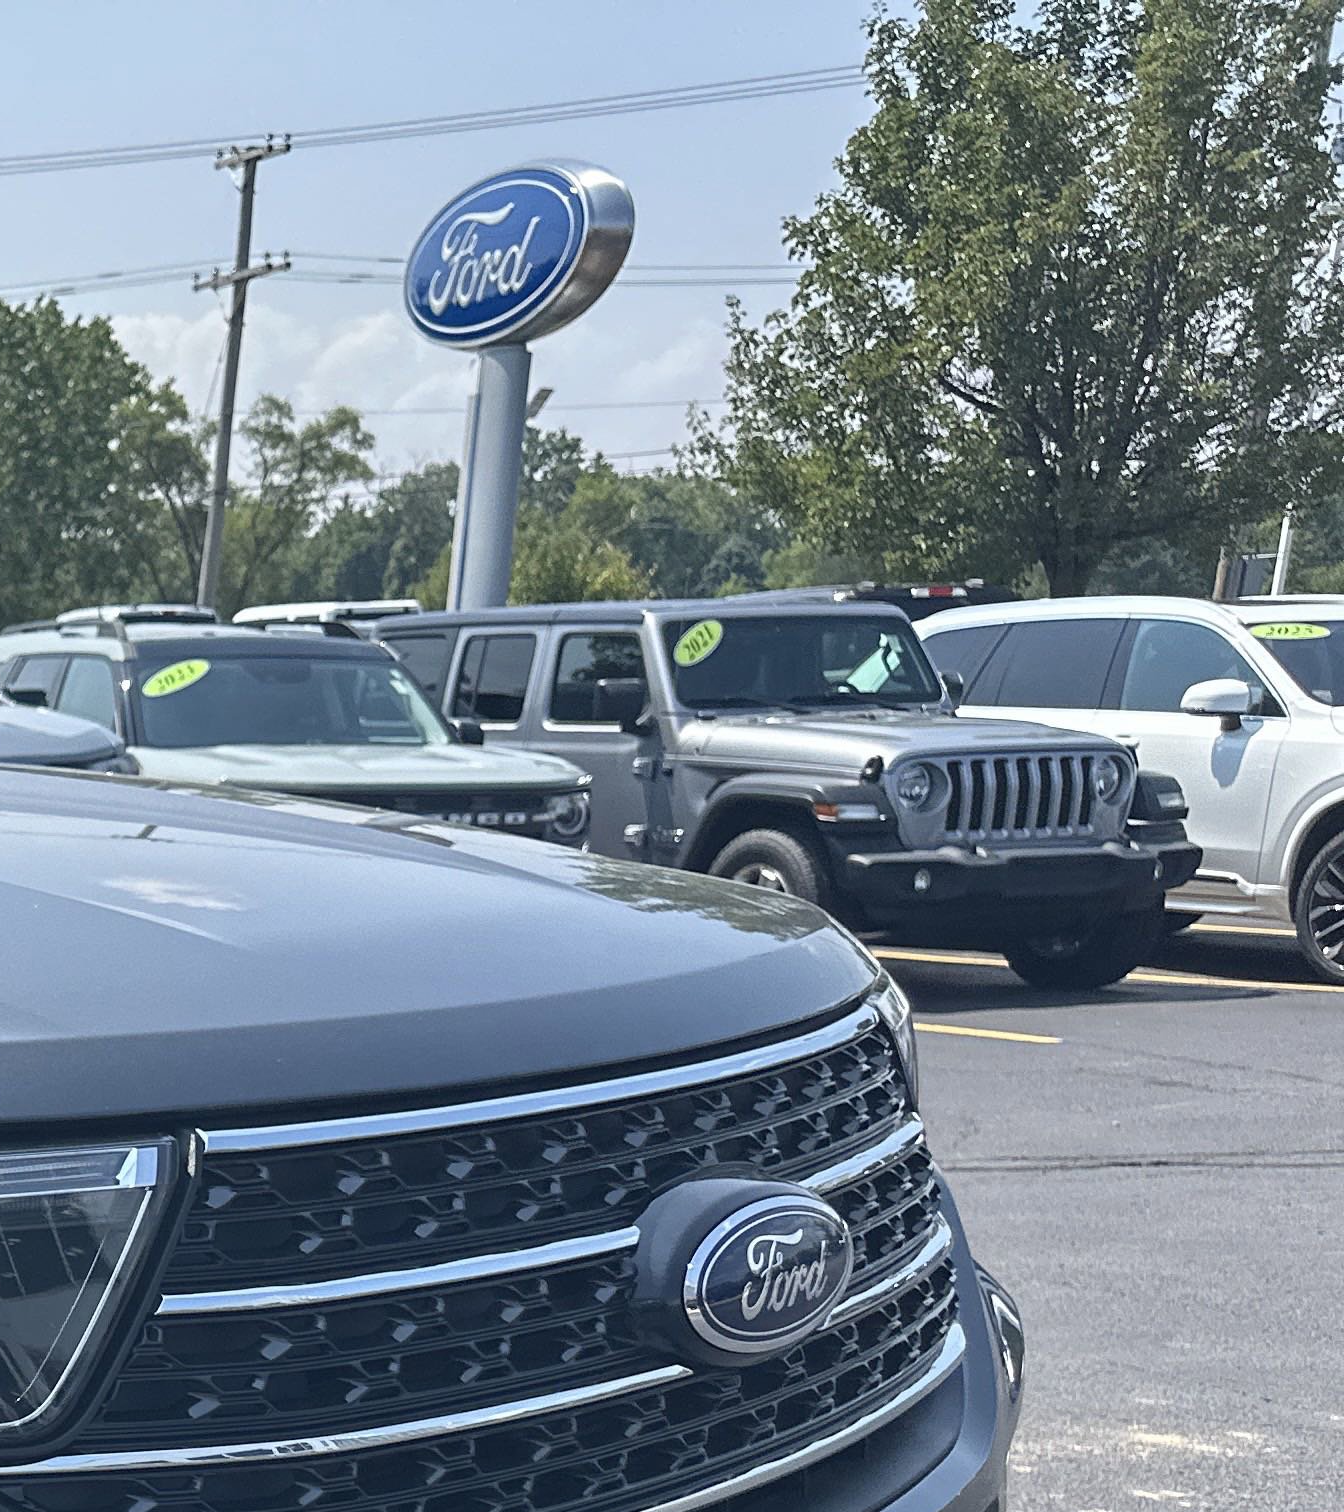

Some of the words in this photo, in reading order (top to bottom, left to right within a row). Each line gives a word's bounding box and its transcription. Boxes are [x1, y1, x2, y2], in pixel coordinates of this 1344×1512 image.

[427, 201, 541, 317] Ford
[682, 623, 715, 662] 2021
[741, 1228, 830, 1321] Ford
